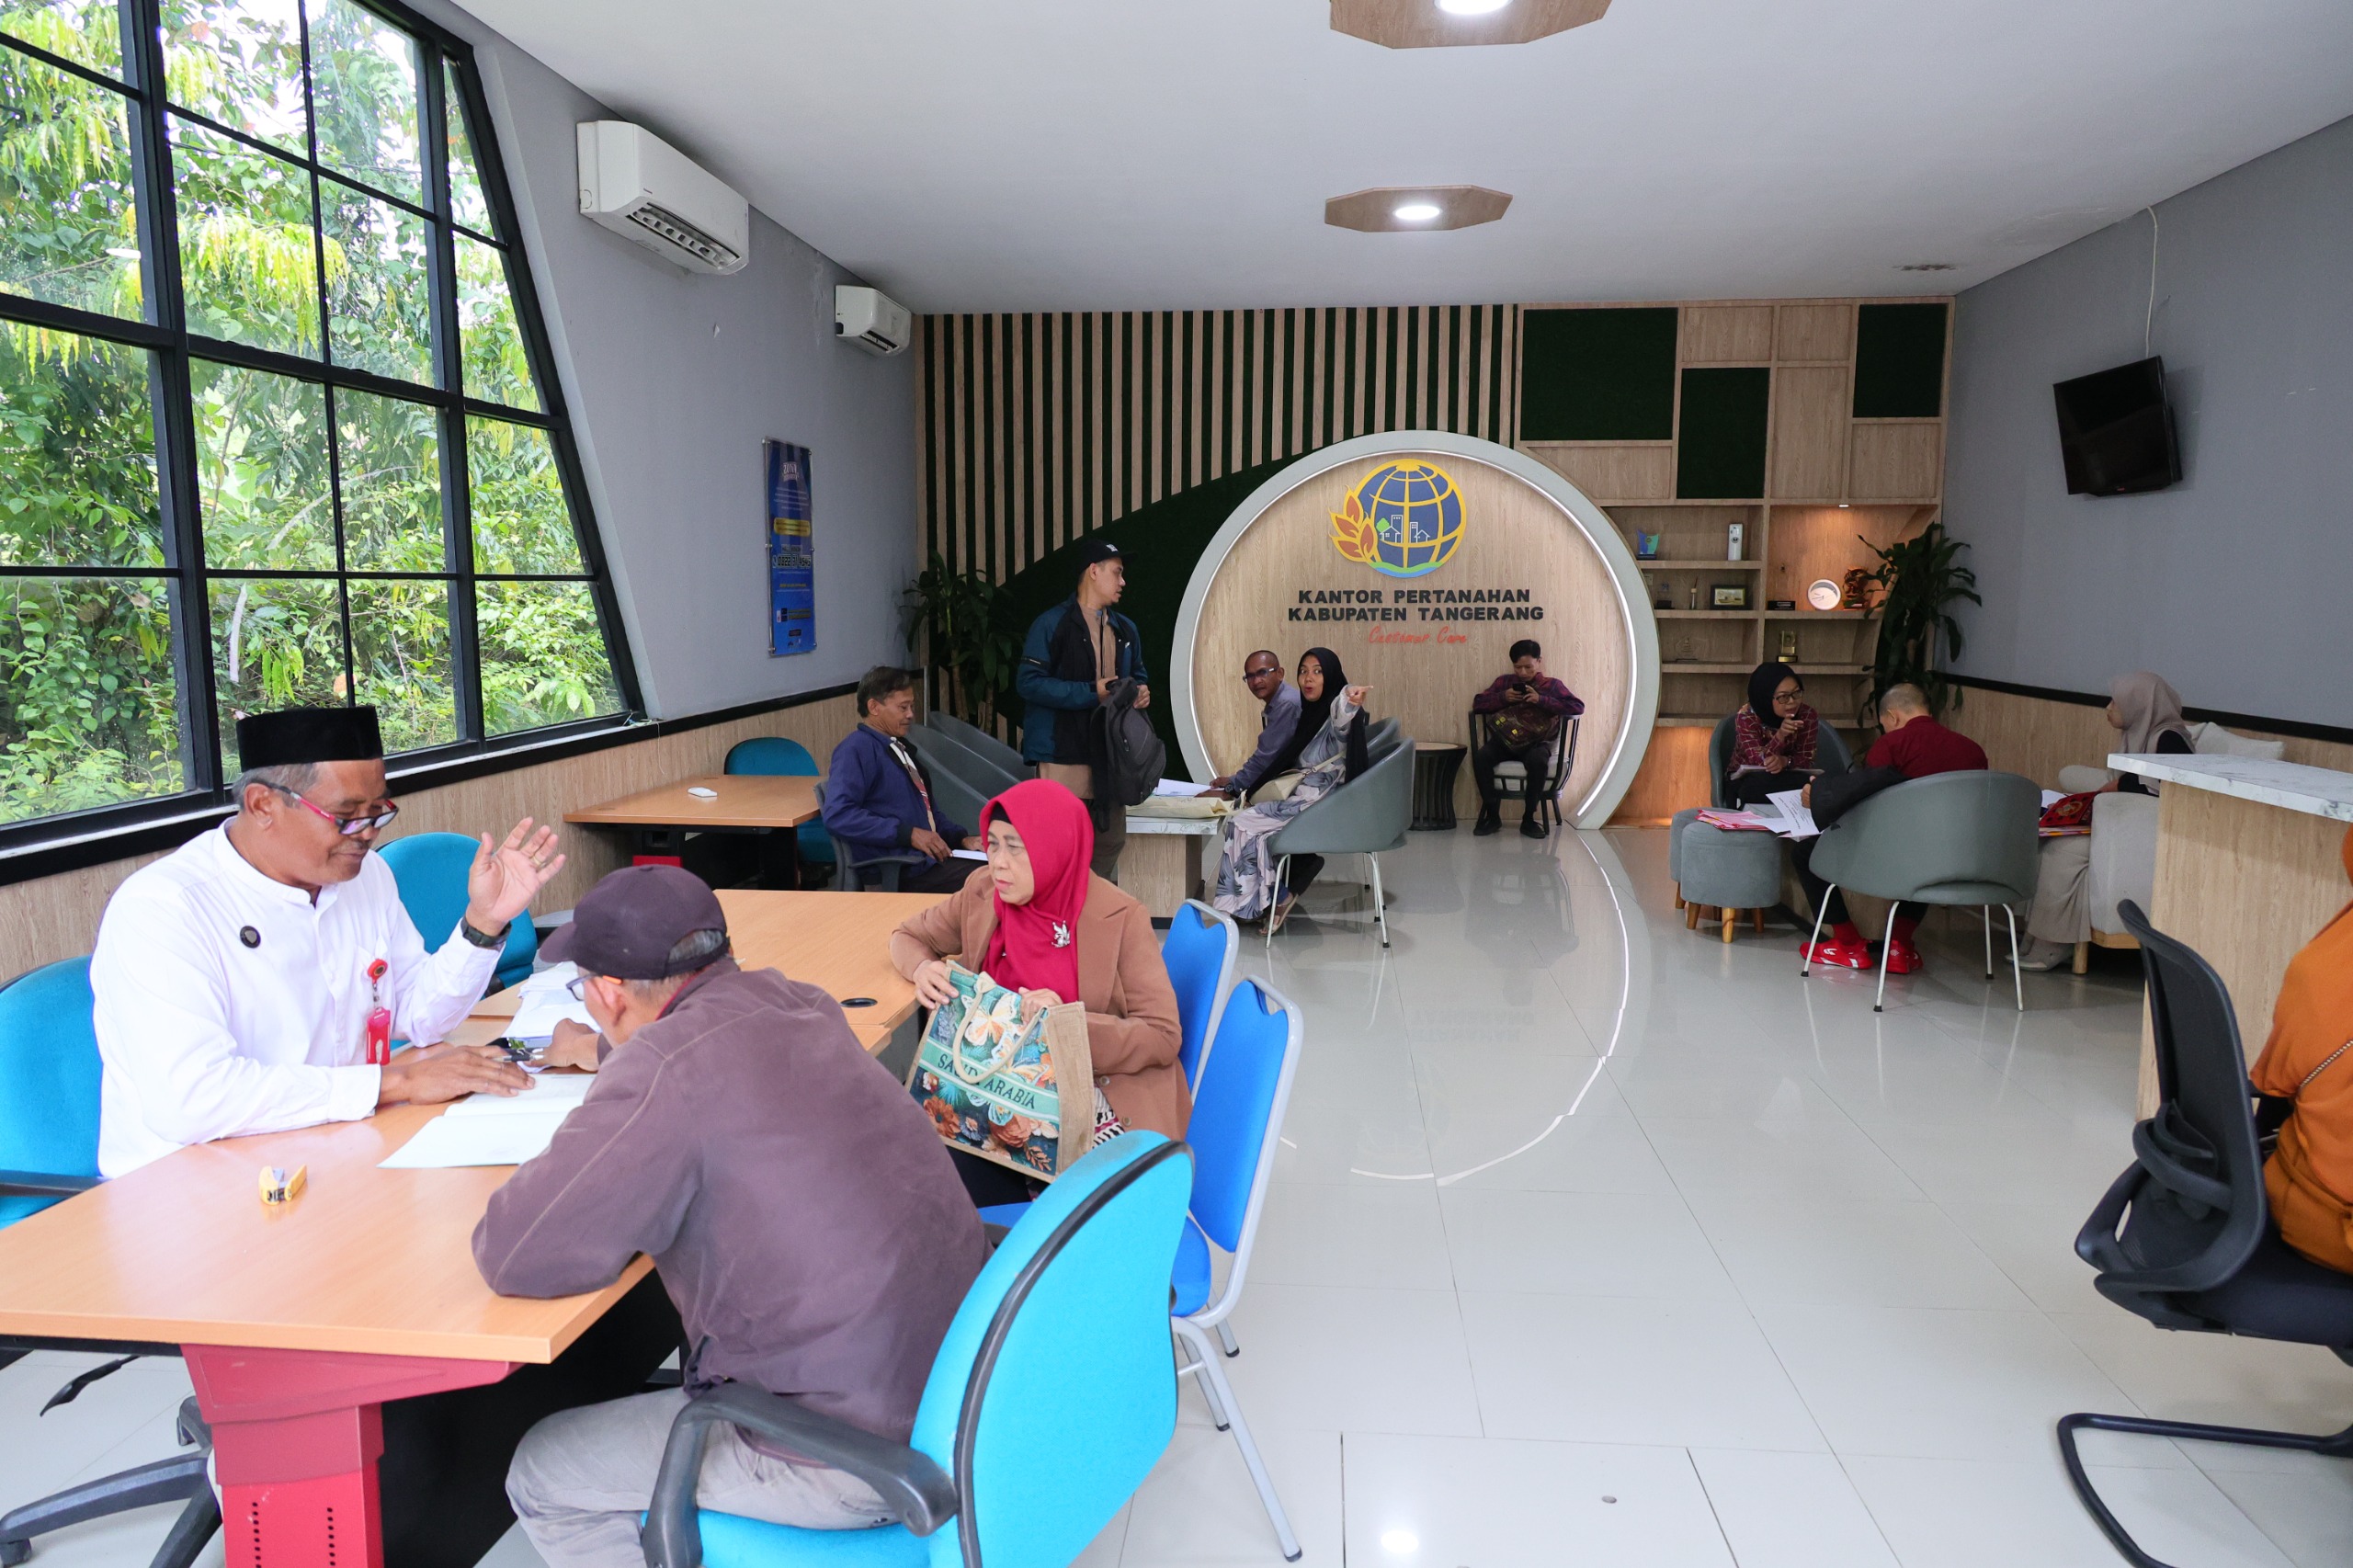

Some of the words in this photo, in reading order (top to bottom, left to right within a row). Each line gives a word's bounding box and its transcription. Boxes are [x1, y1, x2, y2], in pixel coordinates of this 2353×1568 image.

[1299, 590, 1382, 603] KANTOR
[1393, 589, 1530, 603] PERTANAHAN
[1288, 608, 1407, 621] KABUPATEN
[1418, 607, 1544, 620] TANGERANG
[1369, 626, 1430, 643] Customer
[1437, 626, 1467, 643] Care
[983, 1078, 1035, 1109] ARABIA
